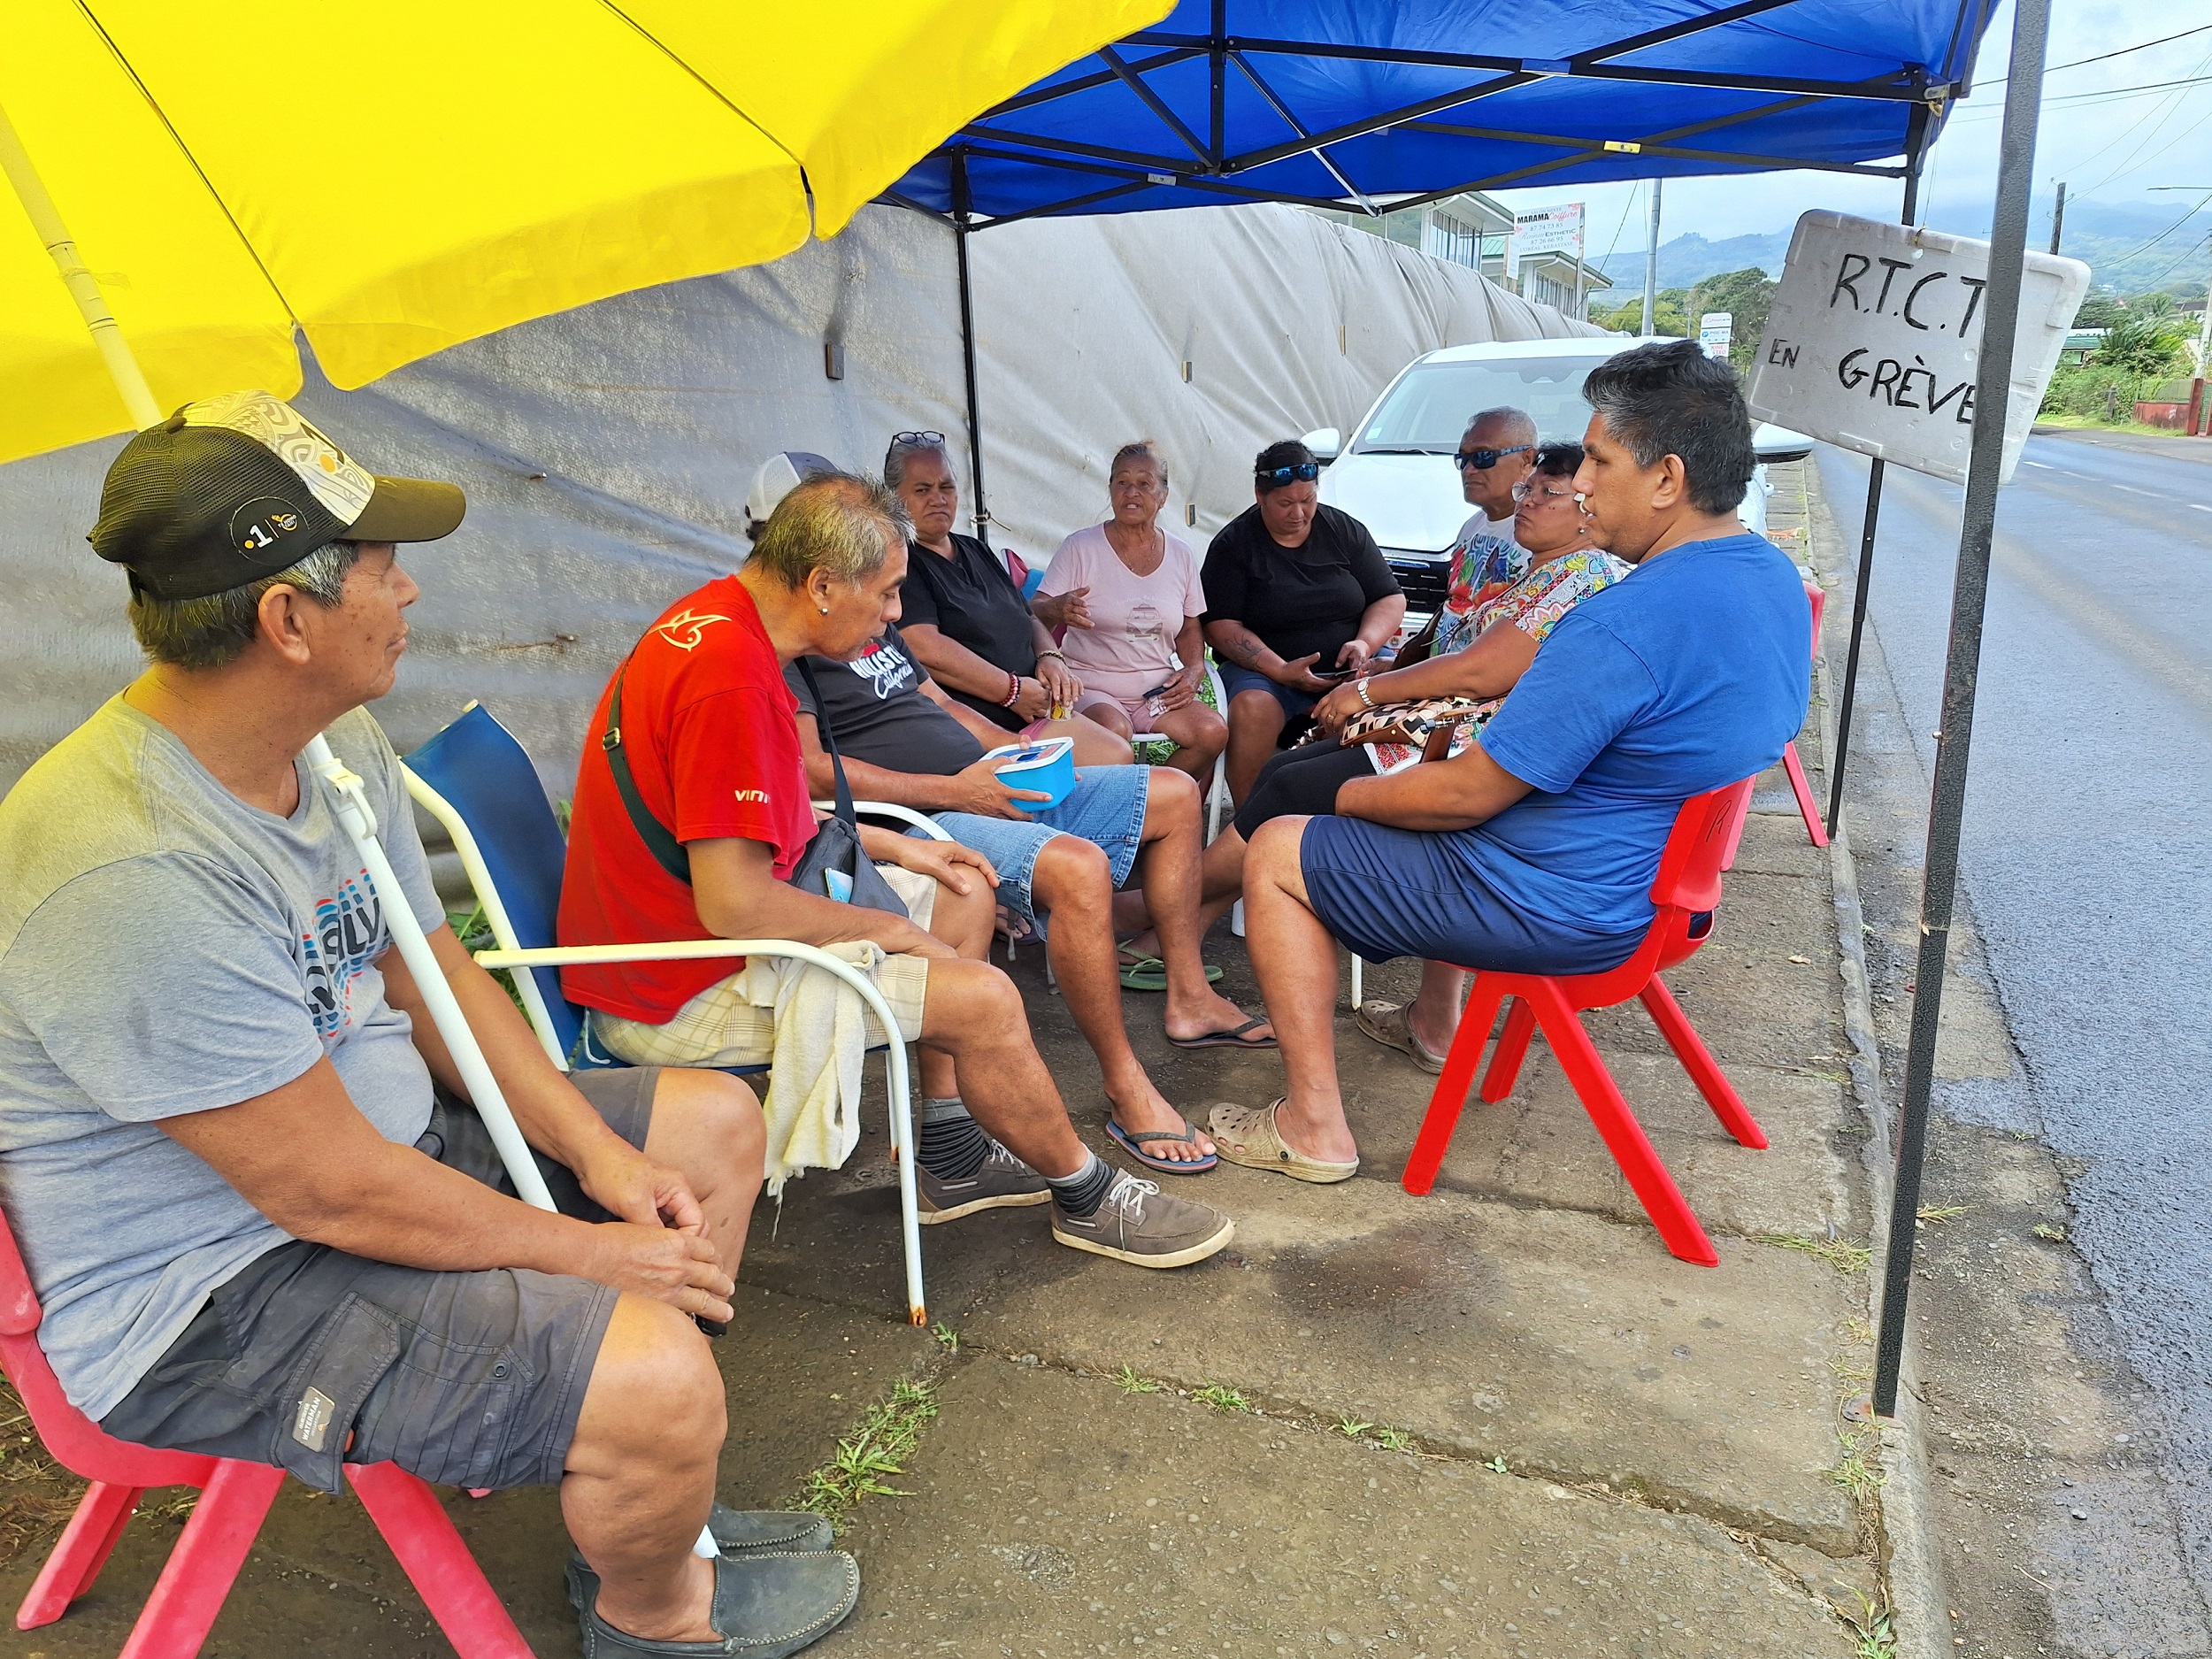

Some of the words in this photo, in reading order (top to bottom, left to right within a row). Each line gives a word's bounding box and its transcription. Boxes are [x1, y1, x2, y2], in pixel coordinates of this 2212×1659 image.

[1517, 213, 1549, 224] MARAMA
[1548, 211, 1578, 221] Coiffure
[1768, 338, 1801, 368] EN
[1838, 346, 1976, 424] GRÈVE
[302, 1396, 321, 1441] WATERMAN
